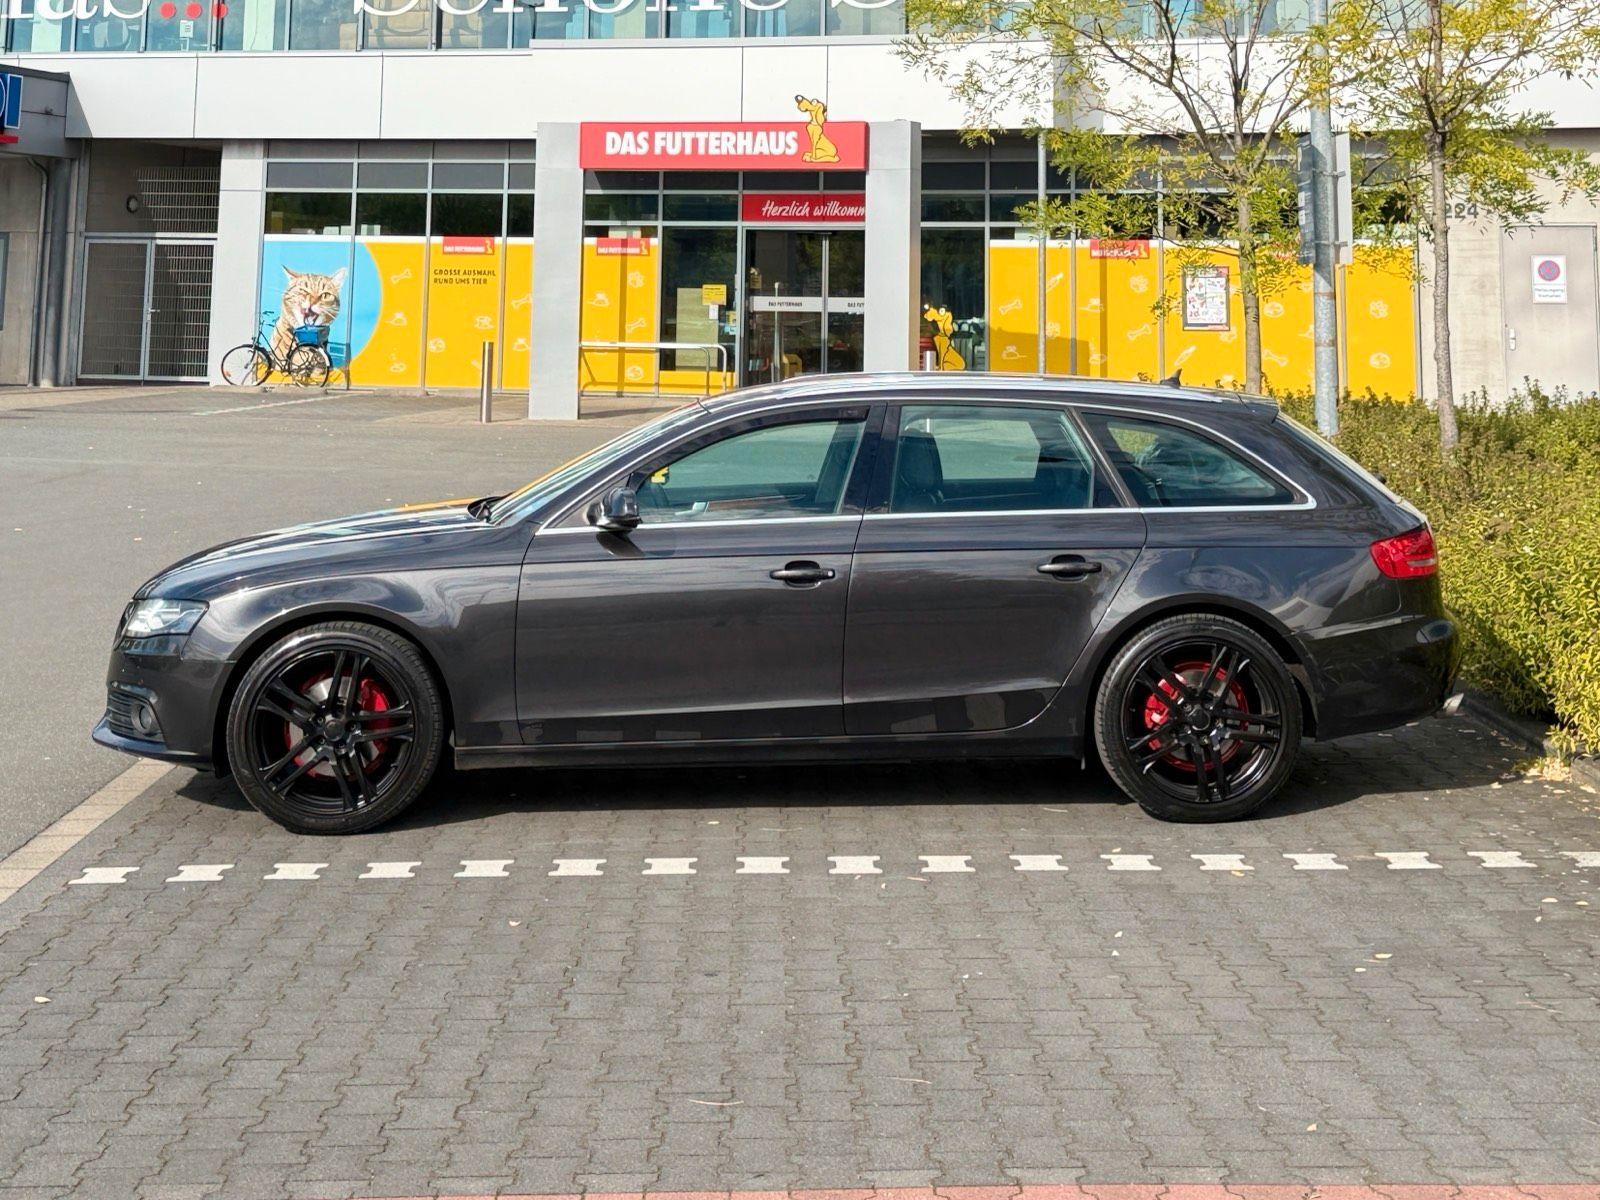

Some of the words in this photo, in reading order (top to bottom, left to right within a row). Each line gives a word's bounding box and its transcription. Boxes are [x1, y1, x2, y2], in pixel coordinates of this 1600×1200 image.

[605, 131, 649, 155] DAS
[654, 131, 798, 155] FUTTERHAUS
[762, 200, 810, 218] Herzlich
[433, 268, 461, 276] GROSSE
[462, 269, 496, 277] AUSWAHL
[433, 277, 454, 285] RUND
[472, 278, 488, 286] TIER
